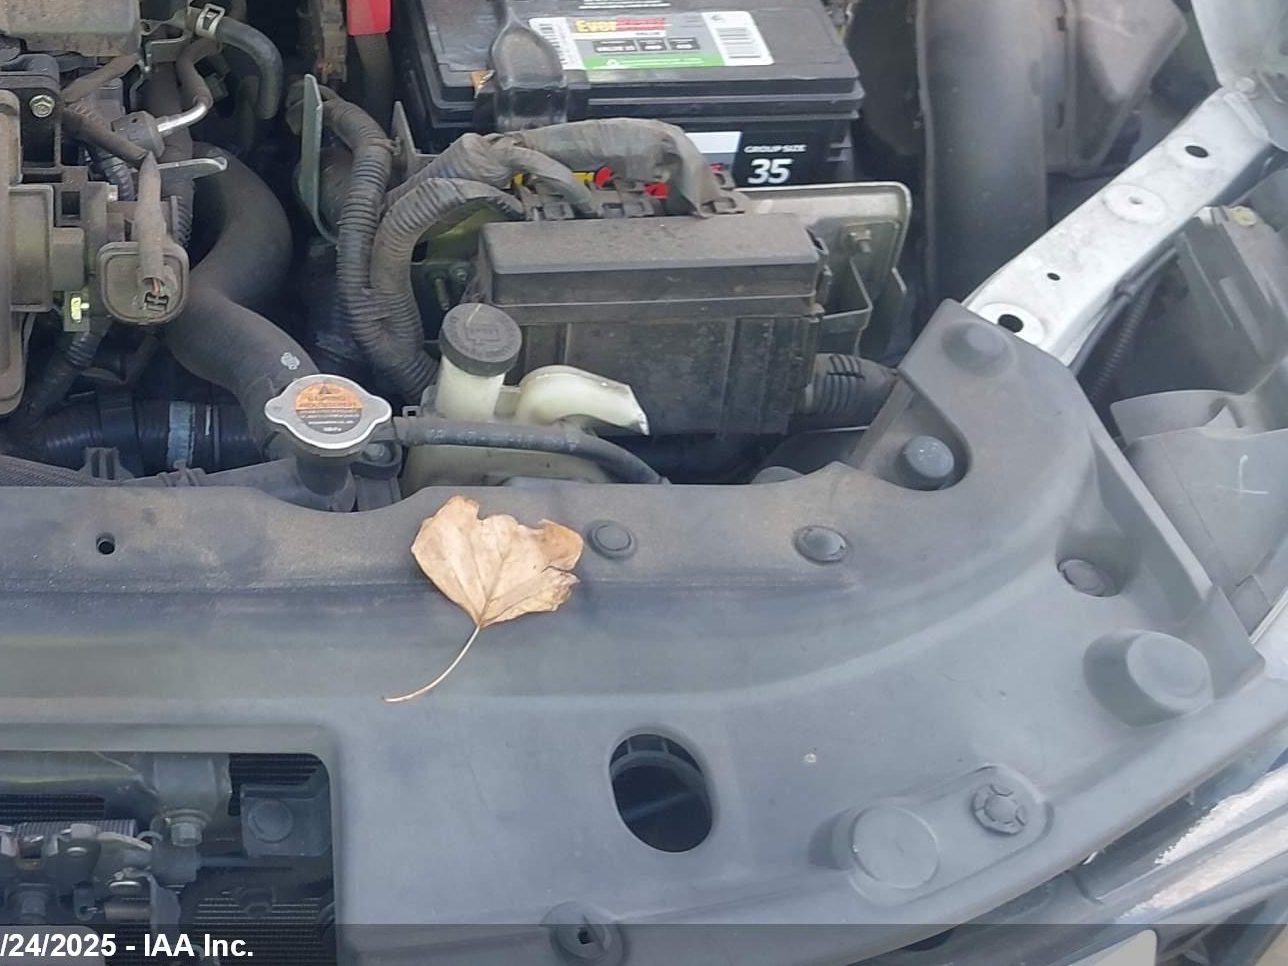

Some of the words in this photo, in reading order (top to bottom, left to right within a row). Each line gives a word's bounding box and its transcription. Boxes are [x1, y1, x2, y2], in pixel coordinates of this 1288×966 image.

[743, 144, 782, 153] GROUP
[782, 143, 808, 153] SIZE
[747, 157, 794, 184] 35
